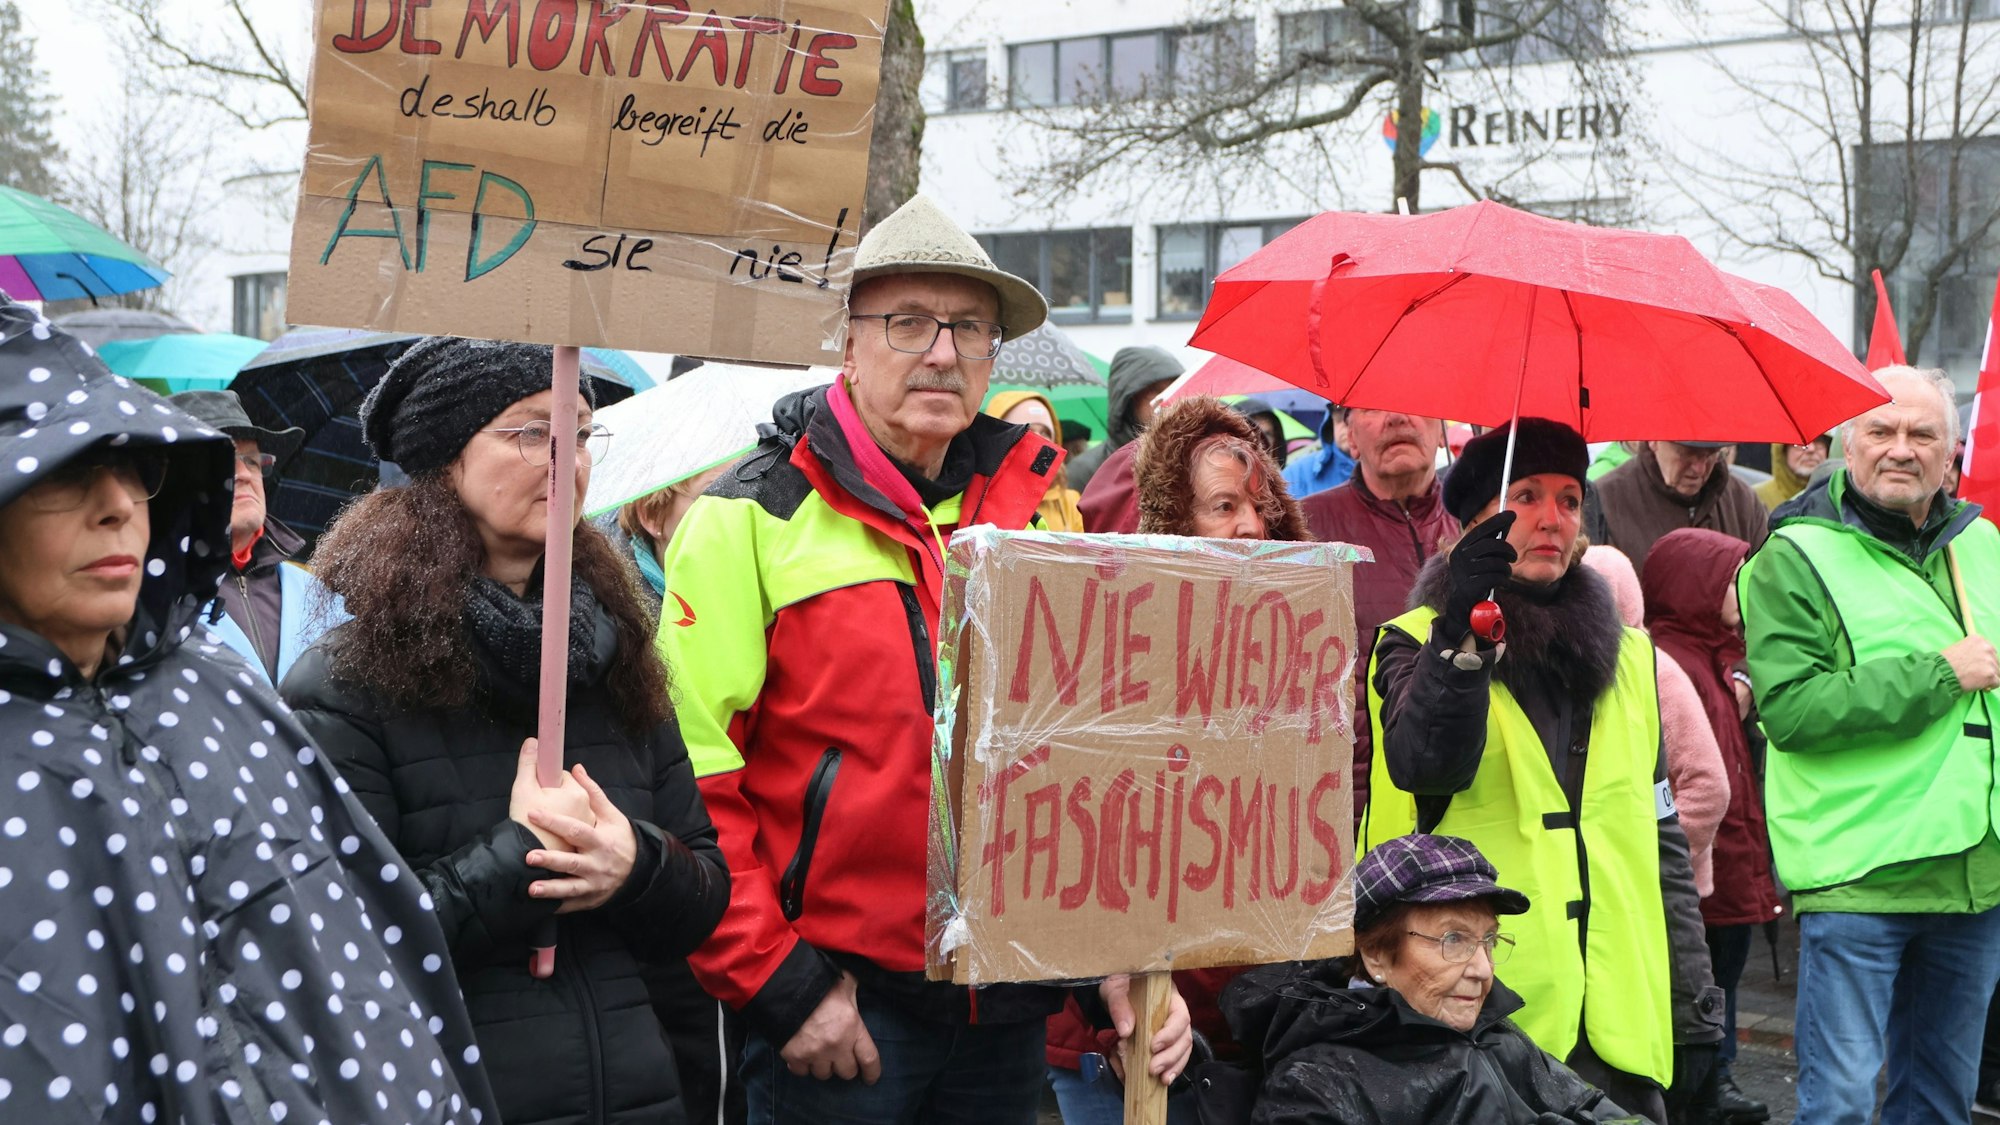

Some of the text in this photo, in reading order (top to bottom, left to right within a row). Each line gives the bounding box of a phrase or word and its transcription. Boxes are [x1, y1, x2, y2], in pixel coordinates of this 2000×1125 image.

[332, 0, 857, 96] DEMOKRATIE
[400, 74, 808, 158] deshalb begreift die
[1450, 103, 1629, 147] REINERY
[320, 154, 849, 289] AFD sie nie!
[1175, 576, 1347, 744] WIEDER
